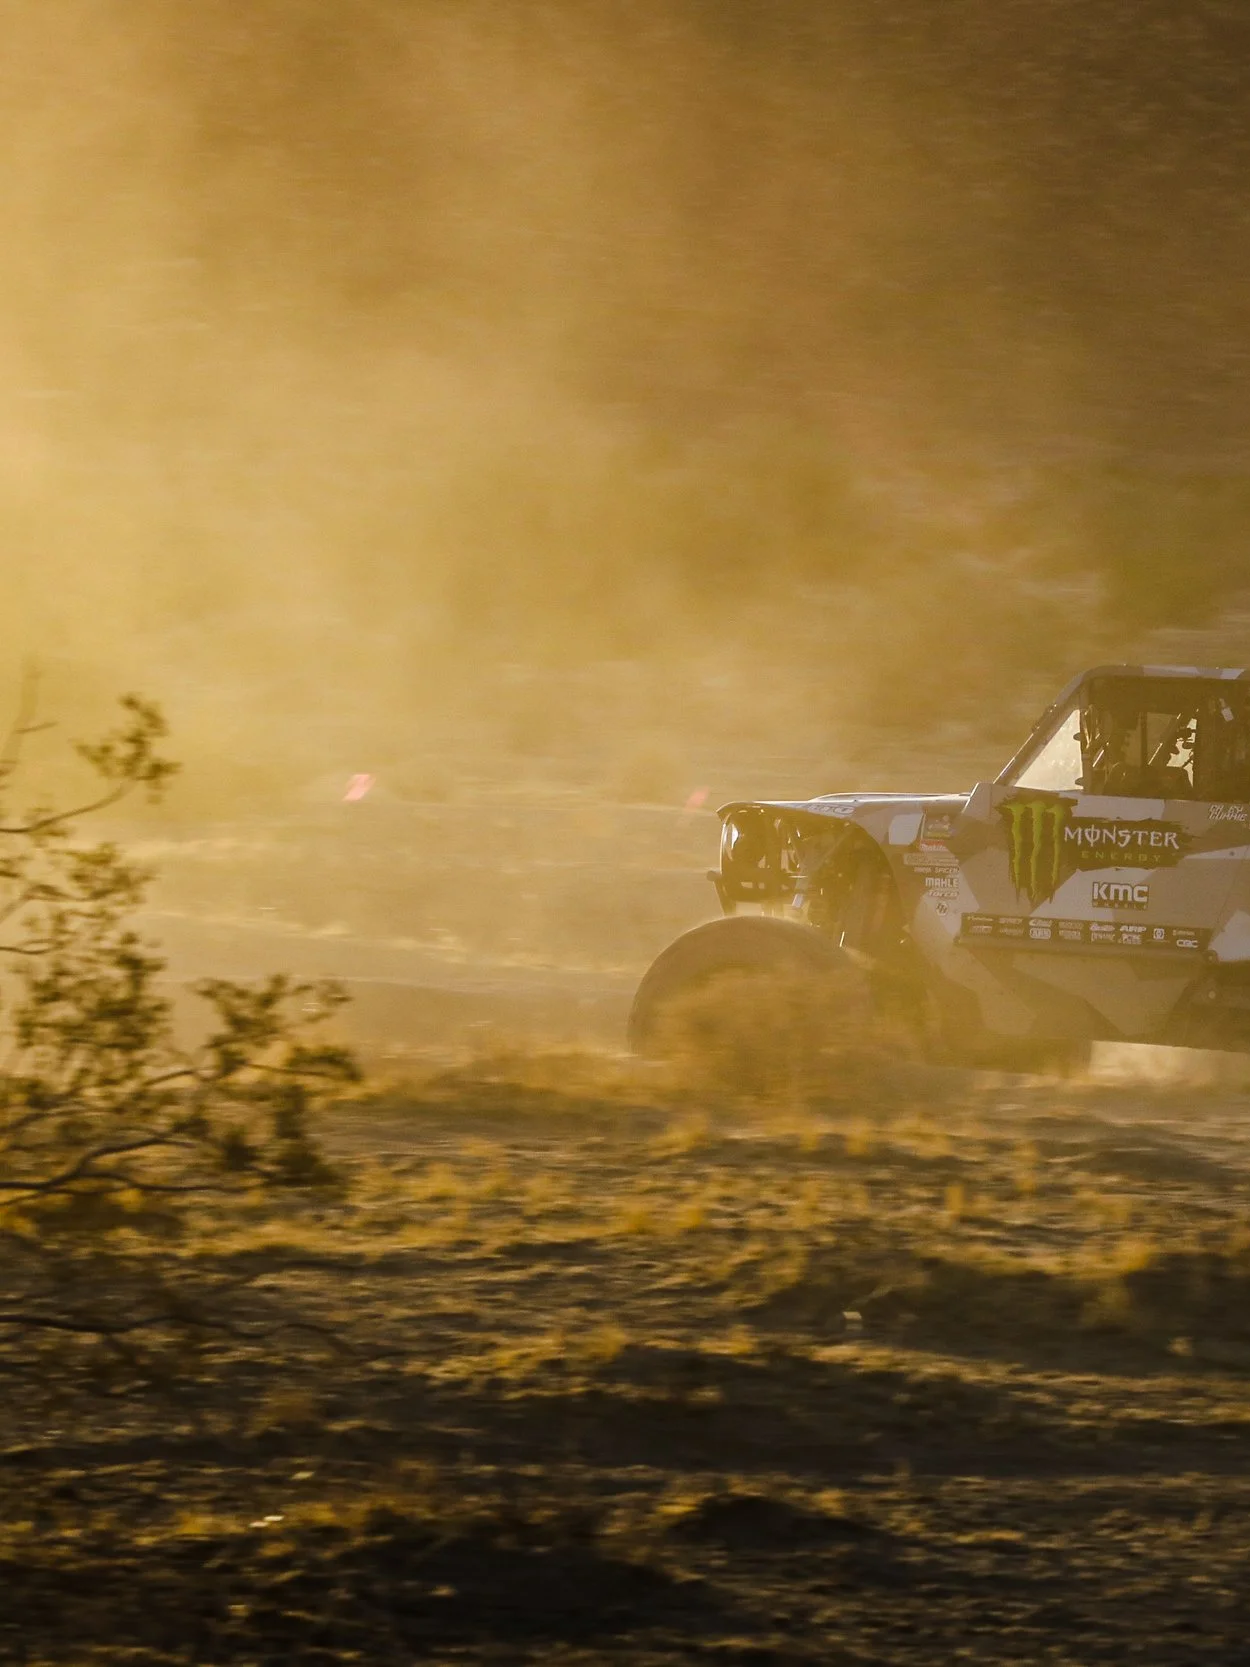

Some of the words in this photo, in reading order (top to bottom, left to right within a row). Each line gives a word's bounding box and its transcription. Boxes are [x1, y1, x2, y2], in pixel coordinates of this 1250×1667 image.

[1064, 824, 1179, 850] MONSTER
[1081, 850, 1161, 862] ENERGY
[925, 876, 959, 888] MAHLE
[1092, 882, 1149, 903] KMC
